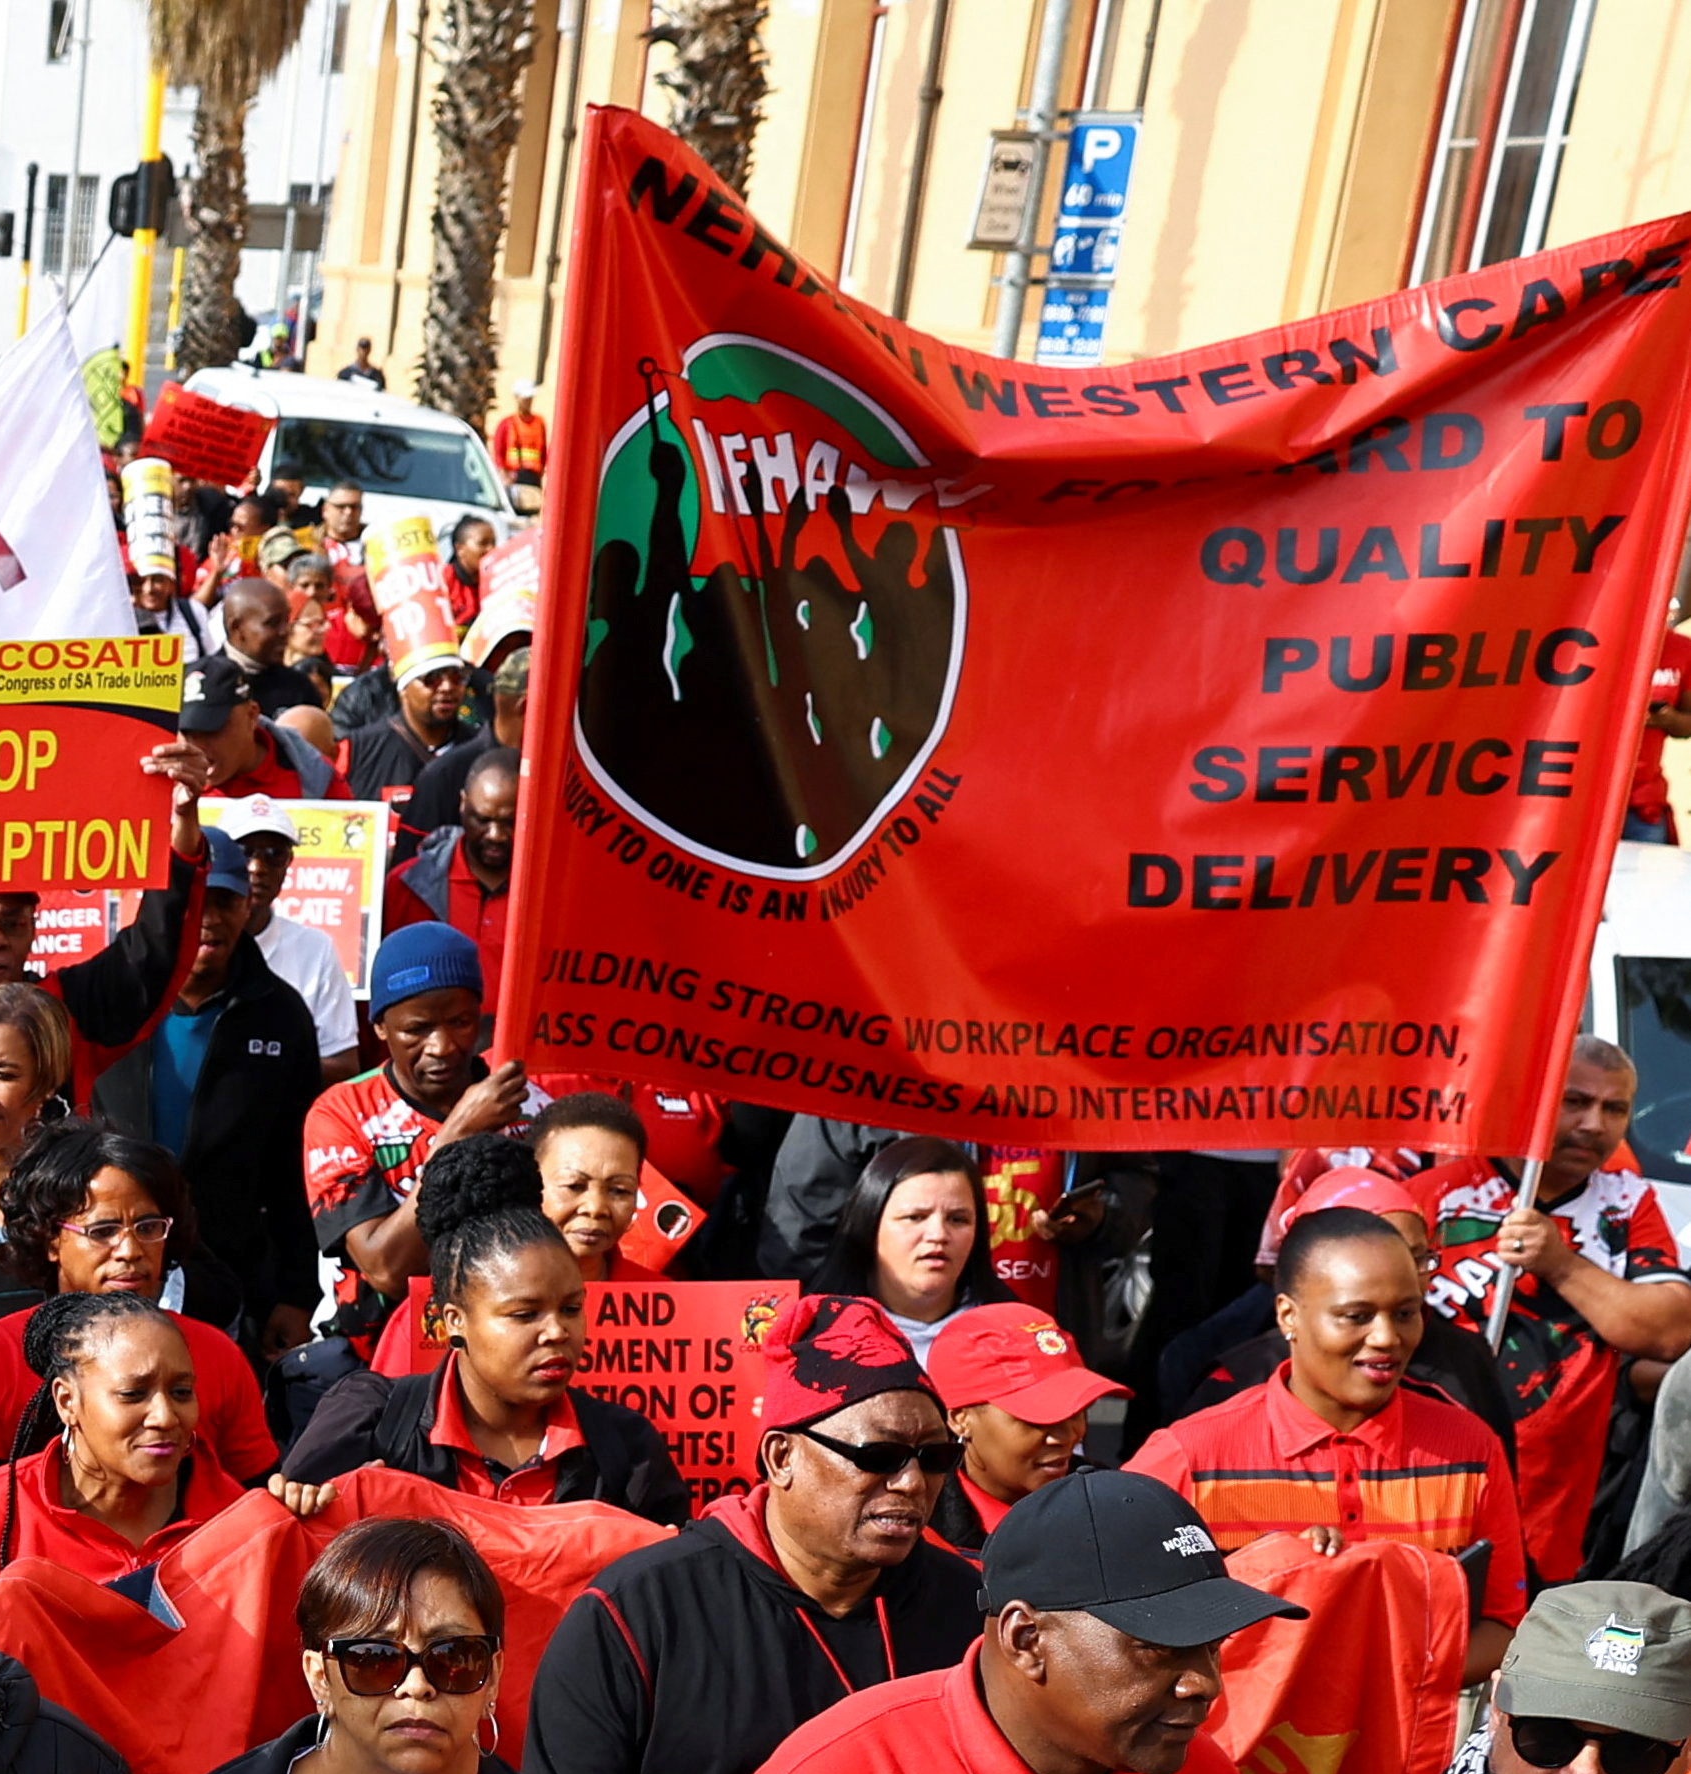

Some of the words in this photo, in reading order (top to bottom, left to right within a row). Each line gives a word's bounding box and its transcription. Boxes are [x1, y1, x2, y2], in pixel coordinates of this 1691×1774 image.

[1083, 129, 1122, 173] P
[950, 326, 1402, 419] WESTERN
[1523, 400, 1642, 462] TO
[1200, 515, 1627, 588] QUALITY
[58, 673, 74, 691] of
[74, 673, 94, 690] SA
[96, 671, 130, 689] Trade
[133, 671, 178, 688] Unions
[1261, 627, 1600, 694] PUBLIC
[1187, 738, 1581, 803] SERVICE
[617, 824, 647, 865] TO
[647, 851, 715, 903] ONE
[716, 879, 754, 914] IS
[757, 889, 807, 922] AN
[819, 844, 889, 923] INJURY
[883, 815, 923, 858] TO
[925, 766, 963, 824] ALL
[295, 865, 355, 894] NOW,
[1126, 846, 1560, 910] DELIVERY
[708, 979, 894, 1048] STRONG
[903, 1016, 1131, 1059] WORKPLACE
[1143, 1020, 1469, 1067] ORGANISATION,
[605, 1017, 965, 1115] CONSCIOUSNESS
[972, 1085, 1057, 1121] AND
[1068, 1085, 1468, 1126] INTERNATIONALISM
[595, 1291, 676, 1327] AND
[702, 1337, 734, 1373] IS
[688, 1383, 736, 1421] OF
[1162, 1535, 1203, 1553] NORTH
[1174, 1525, 1199, 1537] THE
[1178, 1543, 1206, 1558] FACE
